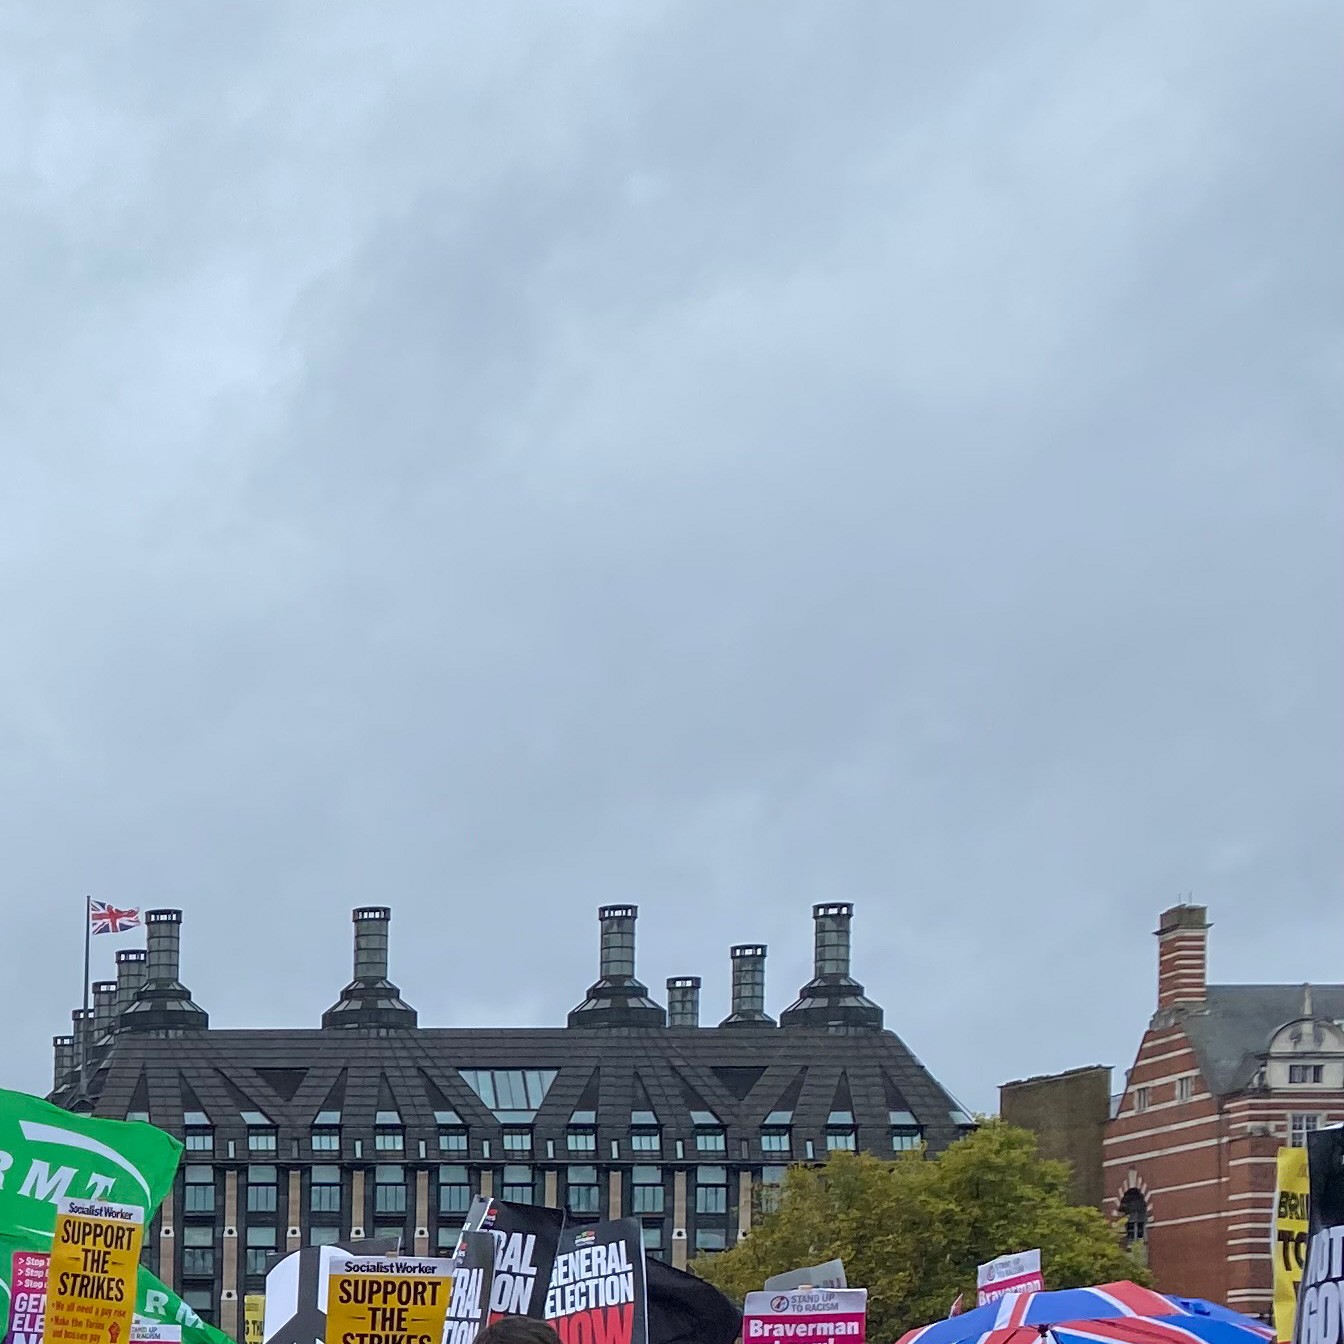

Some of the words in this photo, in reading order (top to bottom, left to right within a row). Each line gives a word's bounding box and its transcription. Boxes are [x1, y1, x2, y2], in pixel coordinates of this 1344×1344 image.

[69, 1202, 103, 1217] Socialist
[103, 1206, 133, 1220] Worker
[61, 1219, 135, 1251] SUPPORT
[25, 1257, 45, 1267] Stop
[82, 1248, 111, 1274] THE
[345, 1261, 394, 1273] Socialist
[395, 1263, 437, 1274] Worker
[25, 1268, 44, 1278] Stop
[24, 1279, 43, 1289] Stop
[58, 1272, 125, 1302] STRIKES
[339, 1279, 441, 1306] SUPPORT
[545, 1272, 634, 1319] ELECTION
[791, 1294, 819, 1303] STAND
[822, 1293, 835, 1302] UP
[792, 1304, 803, 1313] TO
[805, 1302, 839, 1312] RACISM
[368, 1307, 409, 1332] THE
[749, 1319, 859, 1338] Braverman
